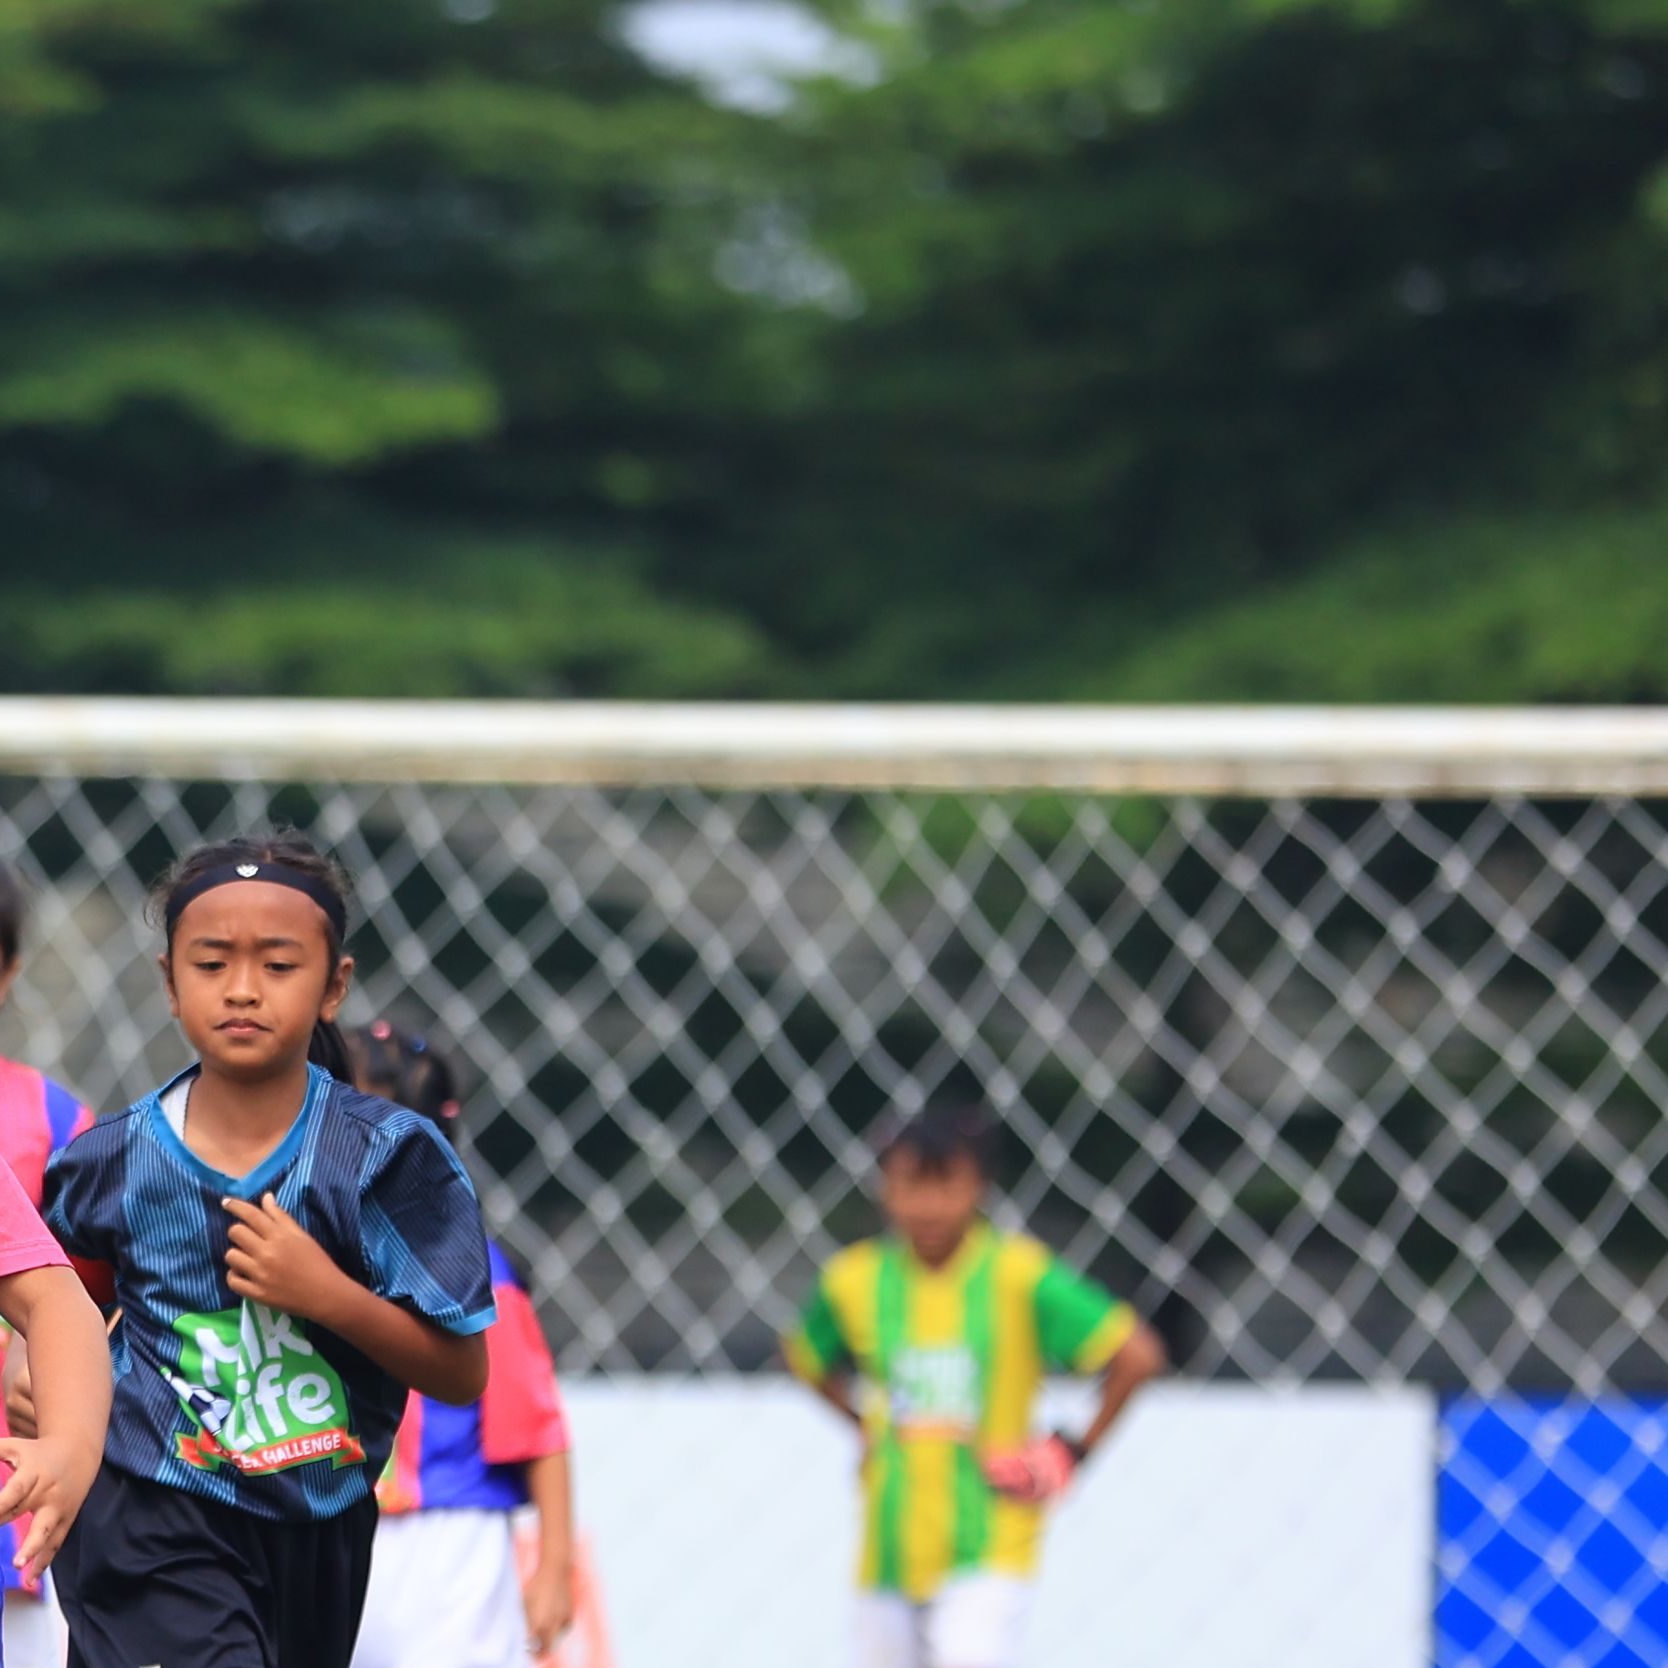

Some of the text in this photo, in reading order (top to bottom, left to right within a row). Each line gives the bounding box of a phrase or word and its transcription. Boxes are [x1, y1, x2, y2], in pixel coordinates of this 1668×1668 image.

[195, 1299, 314, 1387] Mlk
[225, 1363, 336, 1450] Life
[262, 1433, 342, 1465] CHALLENGE
